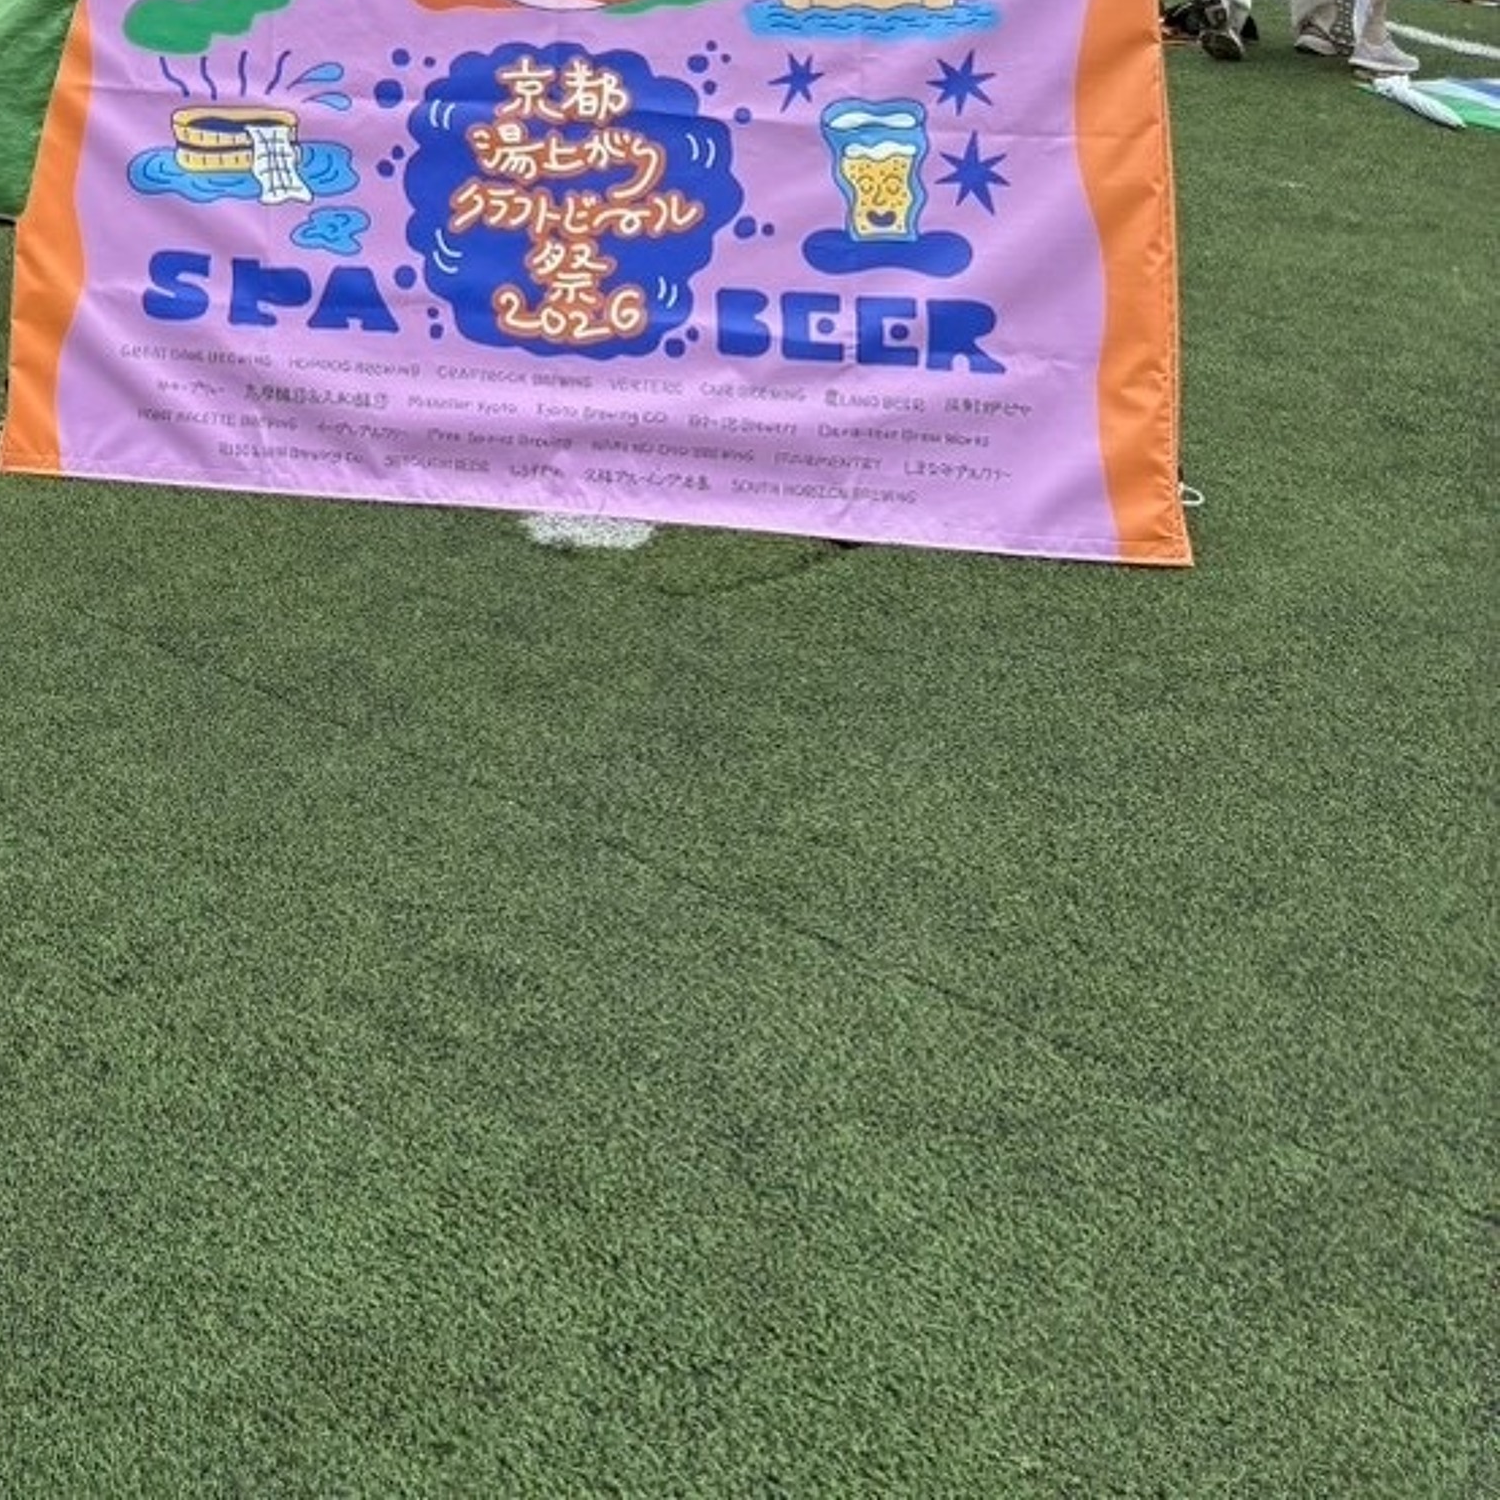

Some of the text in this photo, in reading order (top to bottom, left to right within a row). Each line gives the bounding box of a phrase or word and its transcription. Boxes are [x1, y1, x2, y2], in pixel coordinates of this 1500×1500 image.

[498, 56, 631, 120] 京都
[470, 122, 663, 199] 湯上がり
[452, 182, 701, 233] クラフトビール
[142, 249, 401, 334] SPA
[532, 241, 610, 304] 祭
[497, 287, 642, 341] 2026
[714, 286, 1008, 375] BEER
